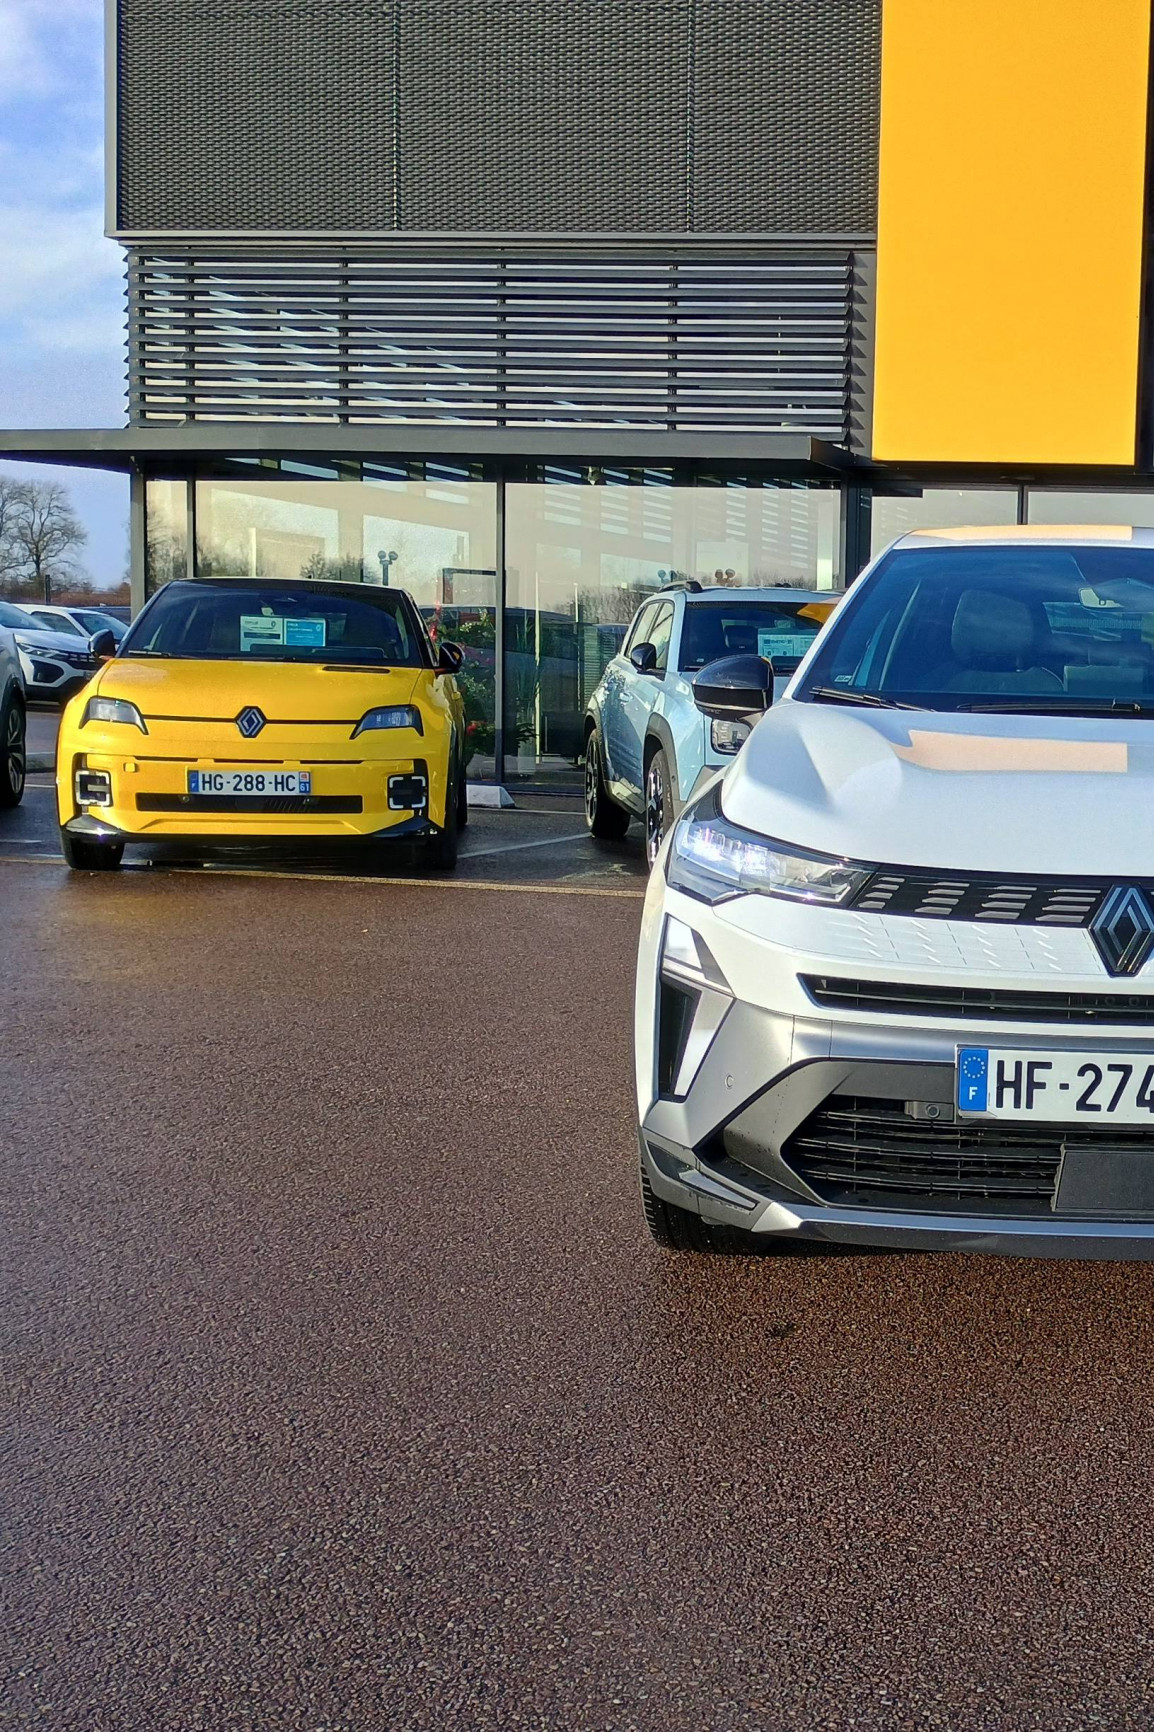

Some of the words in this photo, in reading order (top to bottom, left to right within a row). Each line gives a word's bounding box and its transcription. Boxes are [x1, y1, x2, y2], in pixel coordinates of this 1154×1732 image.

[202, 774, 296, 791] HG-288-HC
[300, 783, 310, 792] 61
[968, 1086, 978, 1100] F
